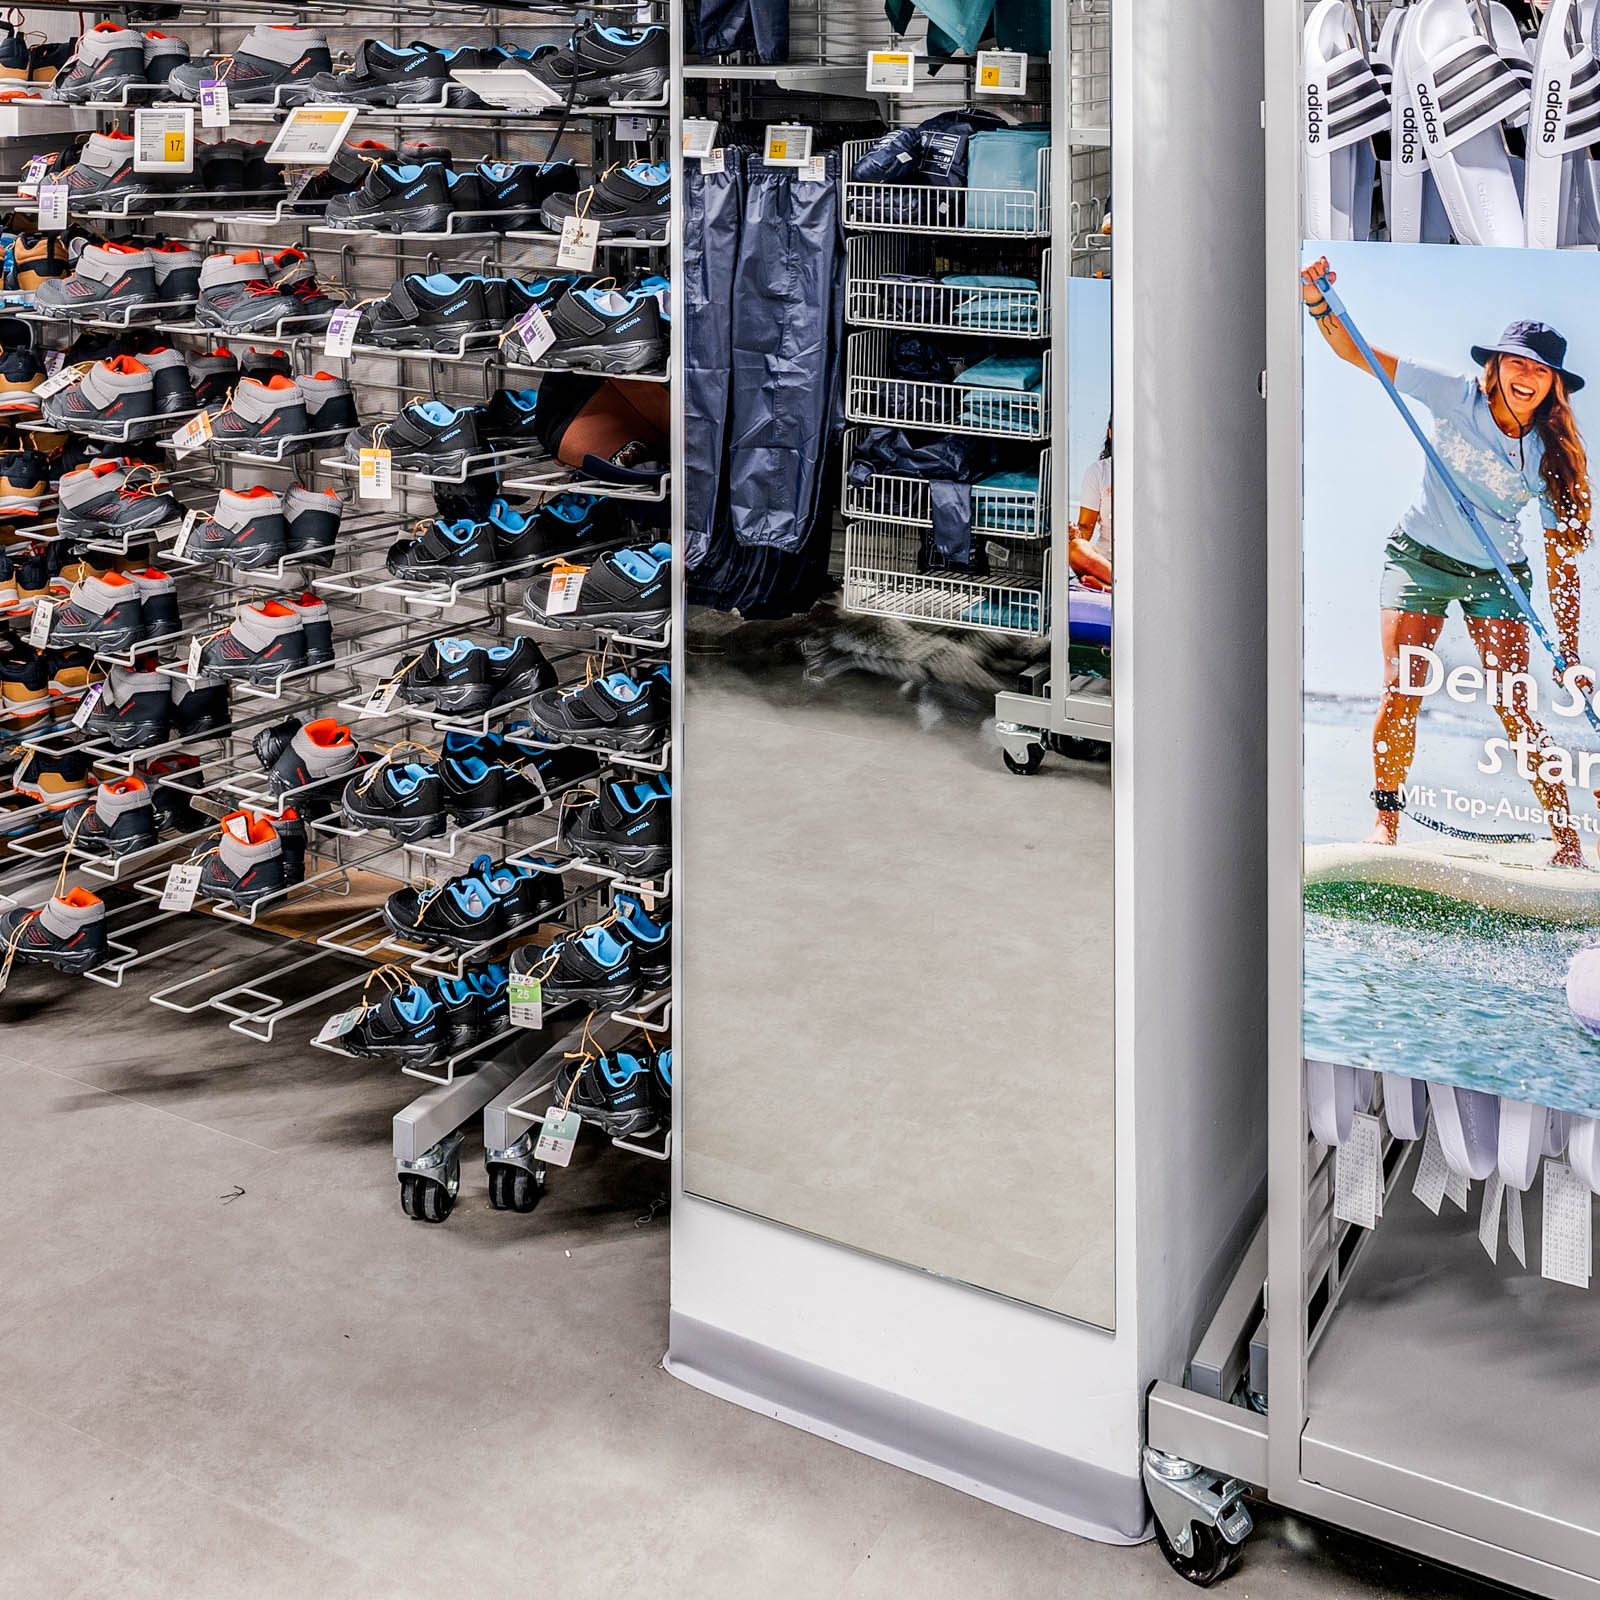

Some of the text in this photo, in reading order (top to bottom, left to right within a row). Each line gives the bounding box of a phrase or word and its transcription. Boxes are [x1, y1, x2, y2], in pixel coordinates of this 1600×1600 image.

[404, 55, 428, 72] QUECHUA
[1307, 83, 1323, 144] adidas
[1416, 82, 1439, 145] adidas
[1542, 79, 1562, 144] adidas
[1401, 106, 1419, 165] adidas
[404, 183, 428, 200] QUECHUA
[497, 183, 518, 199] QUECHUA
[444, 300, 468, 316] QUECHUA
[615, 316, 641, 334] QUECHUA
[440, 428, 461, 443] QUECHUA
[459, 542, 479, 557] QUECHUA
[640, 583, 662, 598] QUECHUA
[1397, 643, 1538, 713] Dein
[1398, 781, 1437, 808] Mit
[626, 821, 650, 837] QUECHUA
[608, 966, 630, 981] QUECHUA
